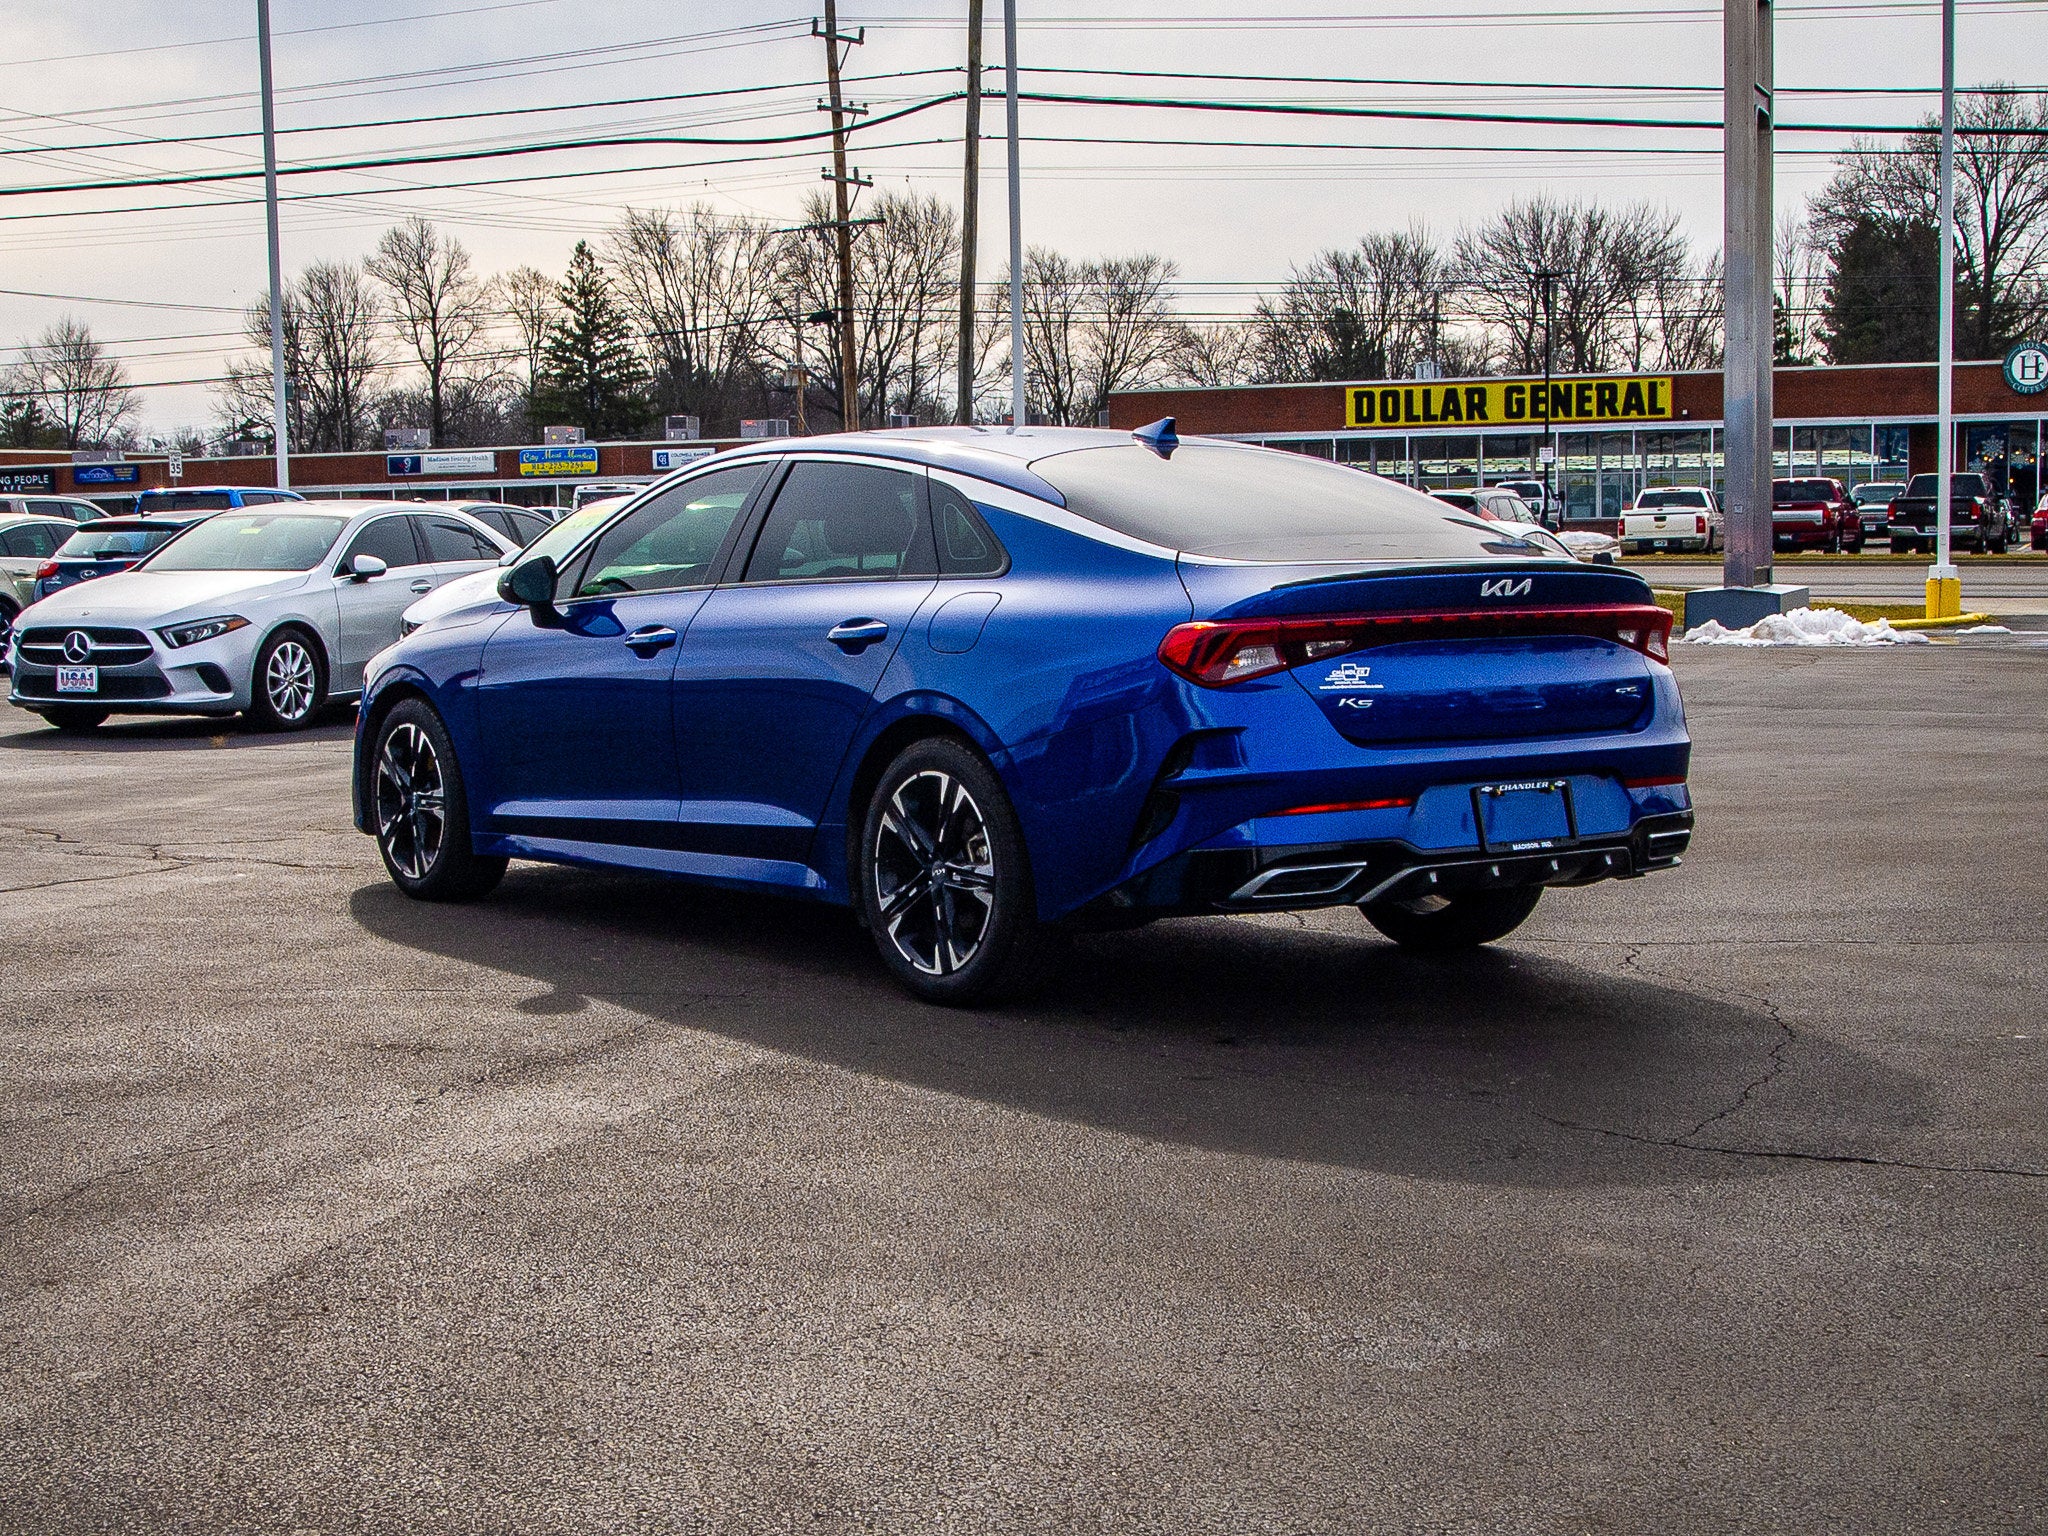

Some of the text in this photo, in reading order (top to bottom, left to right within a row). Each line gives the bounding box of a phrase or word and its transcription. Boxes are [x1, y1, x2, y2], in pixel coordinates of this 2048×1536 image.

[1353, 381, 1666, 423] DOLLAR GENERAL
[170, 463, 182, 474] 35
[14, 474, 49, 485] PEOPLE
[1480, 579, 1532, 597] KIA
[1499, 781, 1549, 791] CHANDLER
